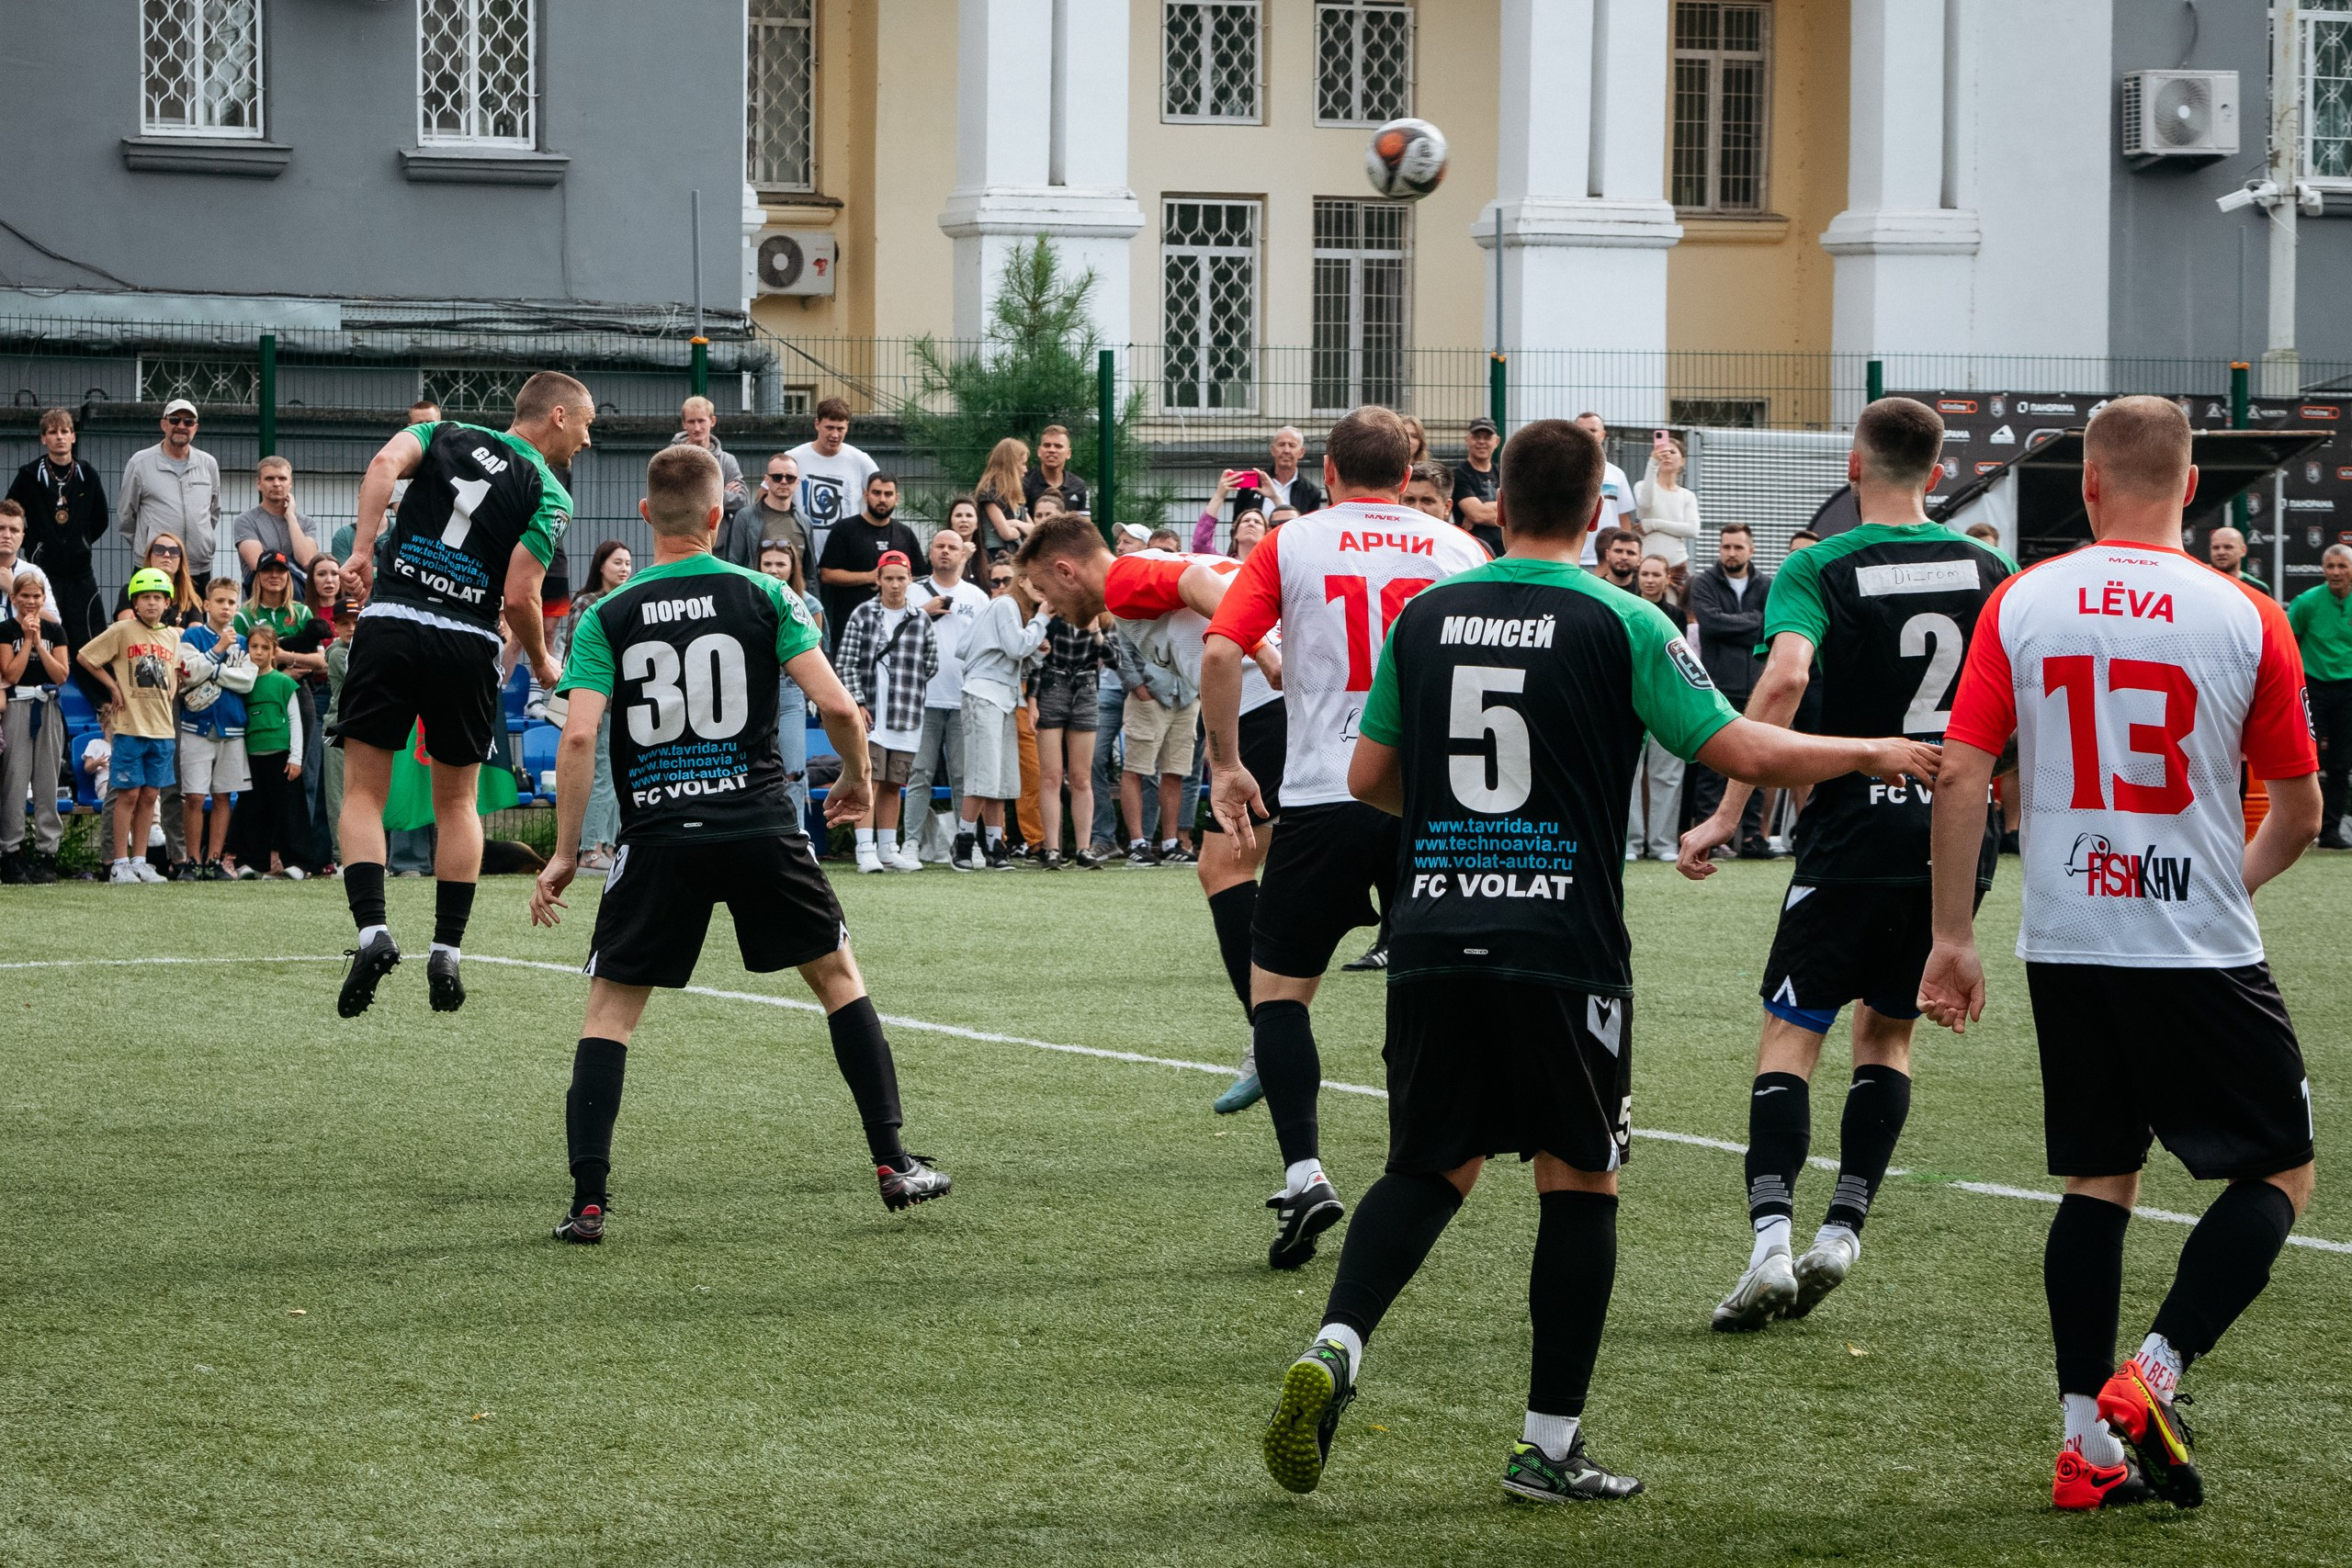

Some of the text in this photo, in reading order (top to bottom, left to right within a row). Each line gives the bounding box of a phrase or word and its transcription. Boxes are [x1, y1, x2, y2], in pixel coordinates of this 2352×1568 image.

[441, 476, 492, 549] 1
[411, 534, 484, 569] www.tarida.ru
[1339, 531, 1434, 556] АРЧИ
[421, 570, 486, 604] VOLAT
[641, 595, 717, 626] ПОРОХ
[1440, 614, 1556, 649] МОИСЕЙ
[127, 643, 148, 659] ONE
[622, 633, 749, 747] 30
[1449, 665, 1532, 814] 5
[2042, 655, 2199, 815] 13
[638, 741, 738, 763] www.tavrida.ru
[631, 763, 749, 789] www.volat-auto.ru
[632, 773, 748, 808] FC VOLAT
[1870, 784, 1907, 805] FC
[1428, 818, 1558, 834] www.tavrida.ru
[1415, 835, 1577, 853] www.technoavia.ru
[1414, 852, 1573, 871] www.volat-auto.ru
[1411, 874, 1574, 900] FC VOLAT
